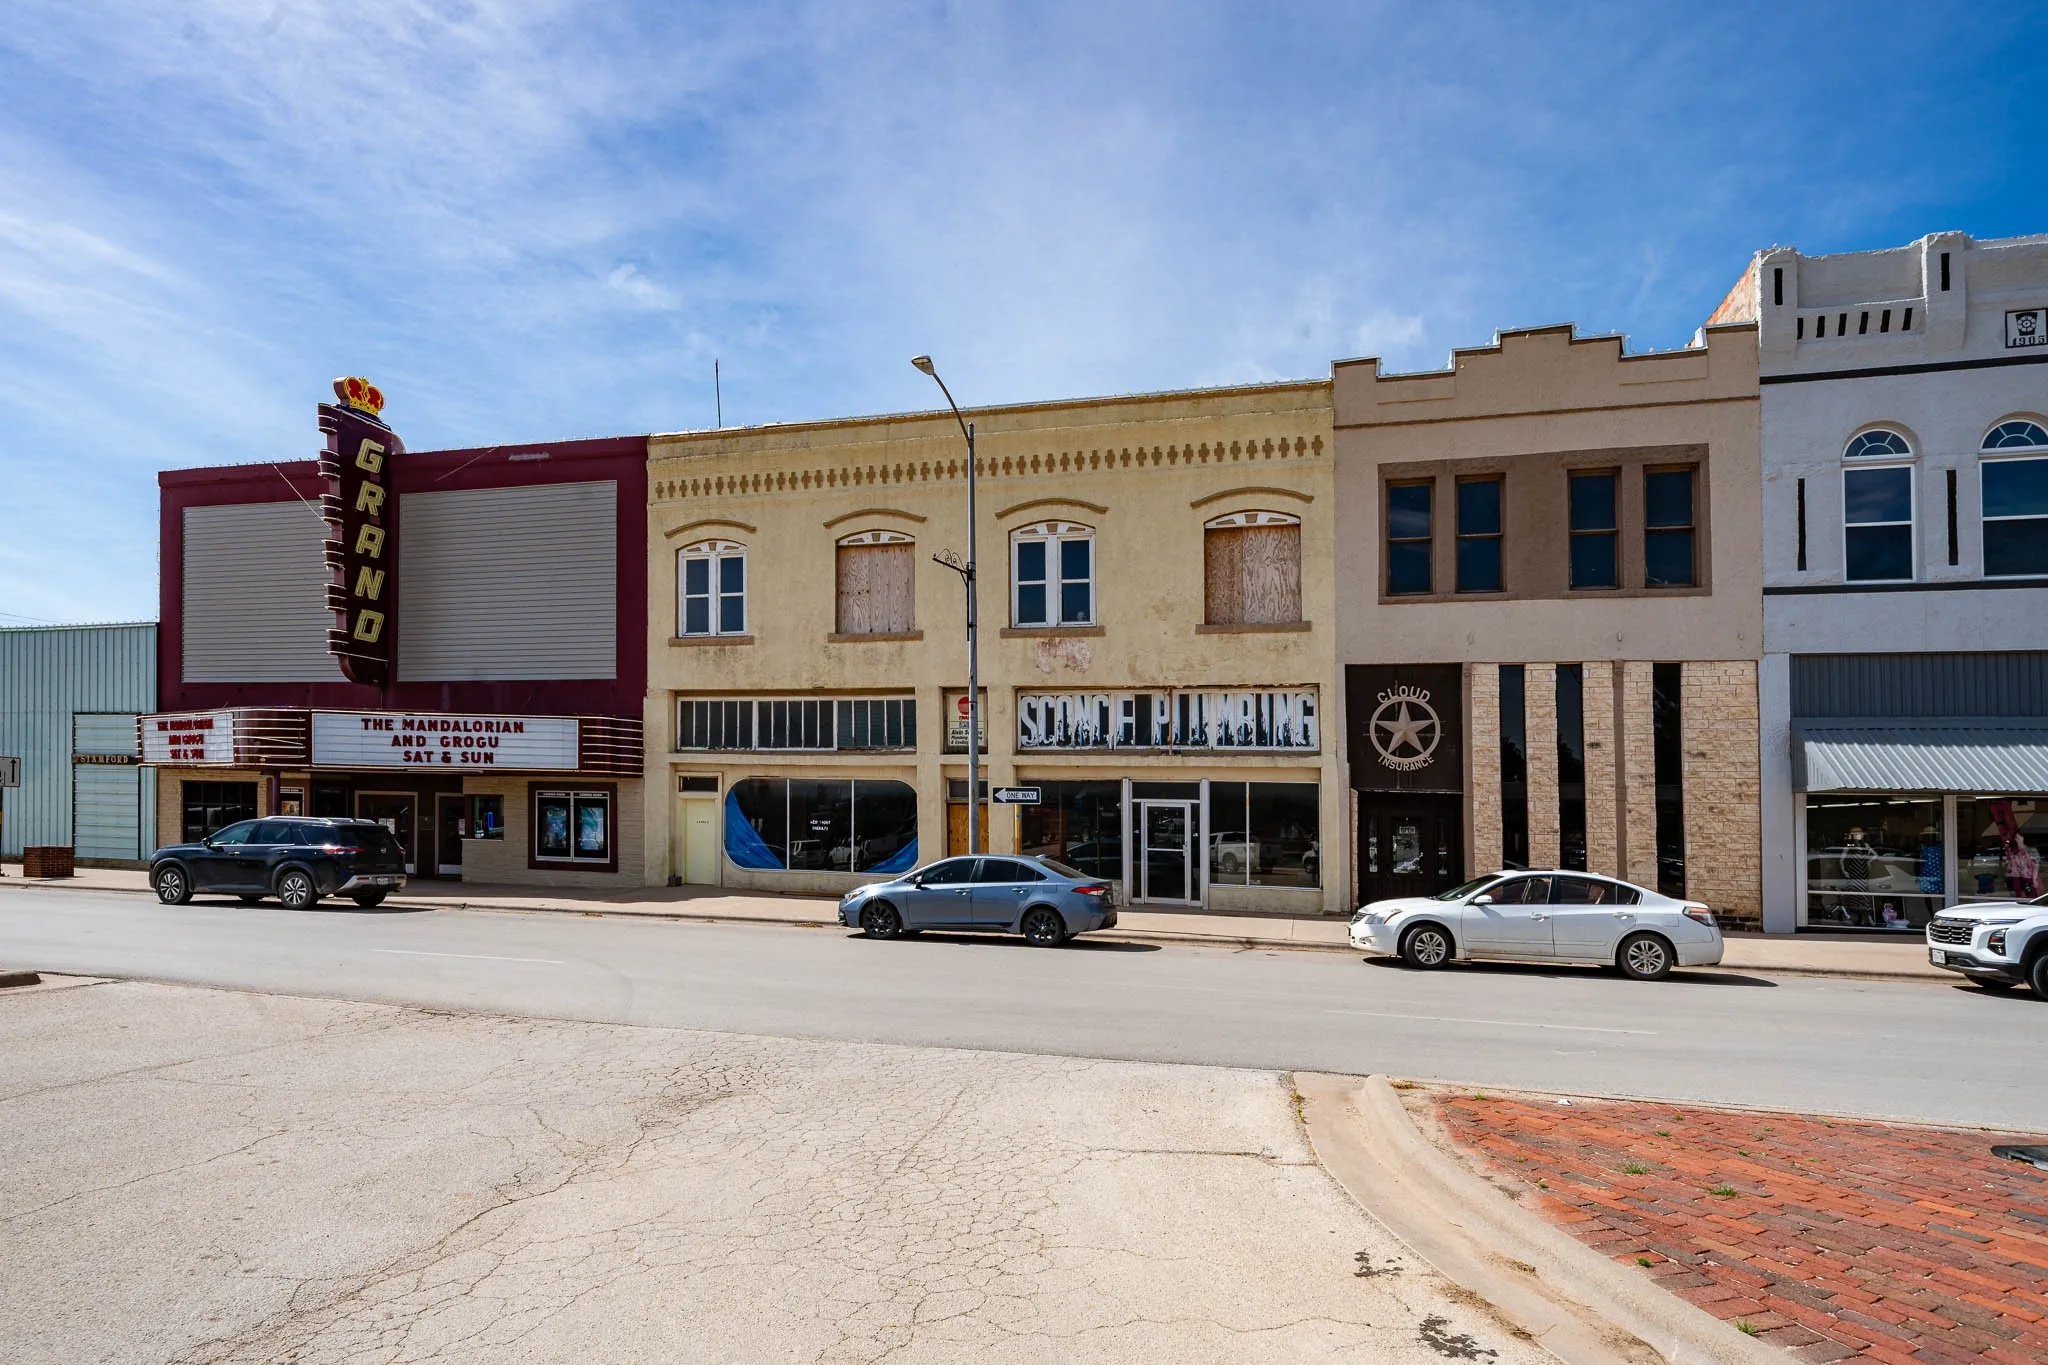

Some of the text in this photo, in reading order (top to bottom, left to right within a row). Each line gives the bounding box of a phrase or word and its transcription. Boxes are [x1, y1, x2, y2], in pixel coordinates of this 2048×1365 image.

[2012, 335, 2046, 346] 1905
[354, 438, 386, 643] GRAND
[1377, 685, 1431, 703] CLOUD
[361, 718, 524, 734] THE MANDALORIAN
[1153, 693, 1316, 747] PLUMBING
[391, 735, 499, 748] AND GROGU
[80, 755, 129, 764] STAMFORD
[402, 750, 494, 764] SAT & SUN
[1378, 755, 1434, 772] INSURANCE
